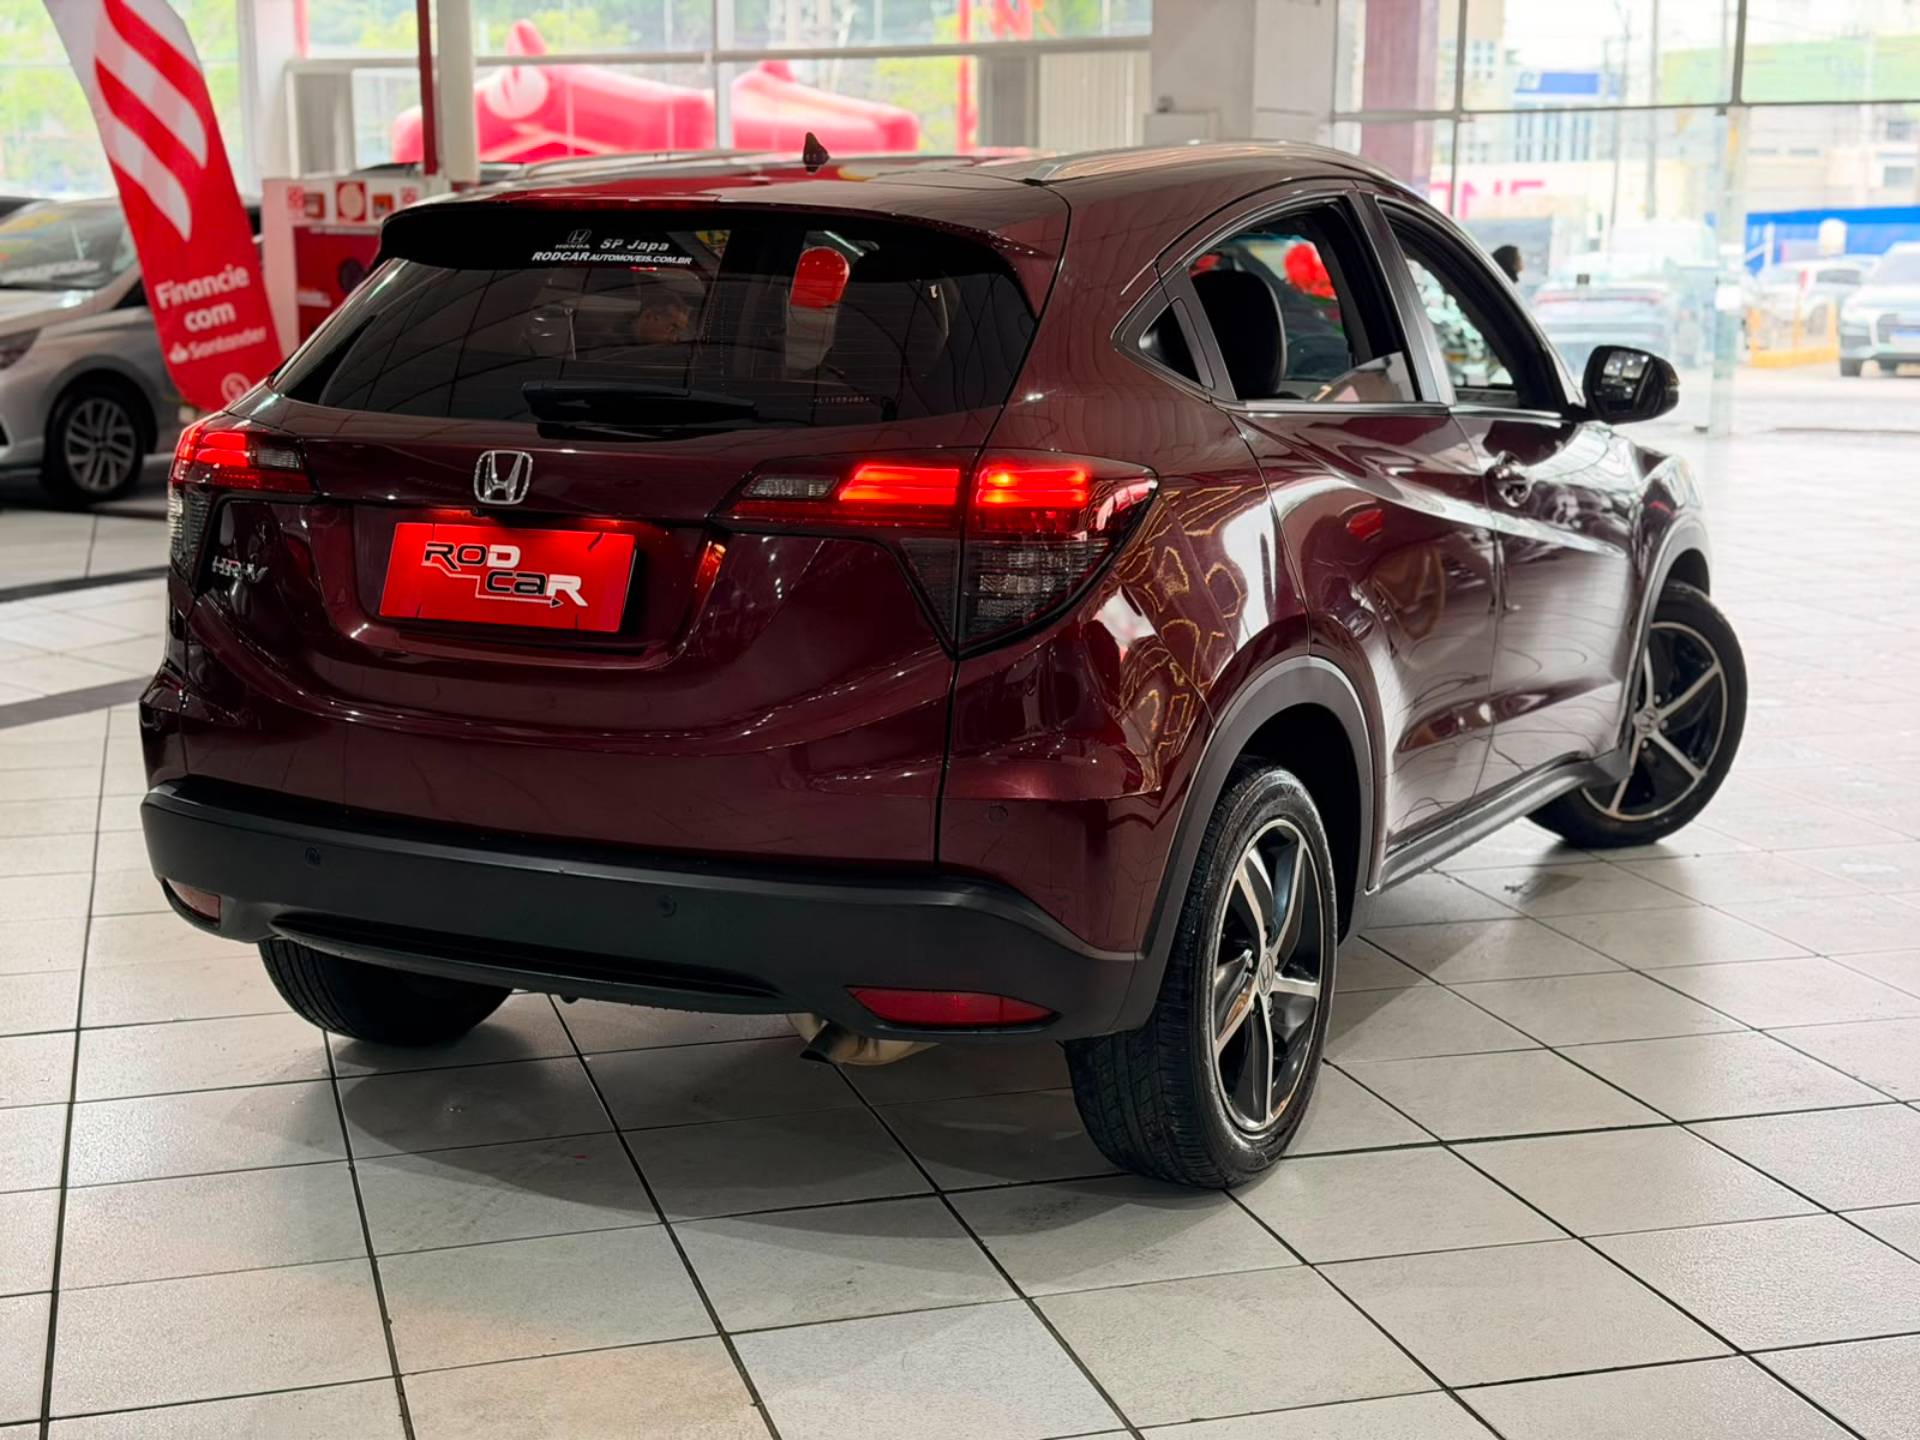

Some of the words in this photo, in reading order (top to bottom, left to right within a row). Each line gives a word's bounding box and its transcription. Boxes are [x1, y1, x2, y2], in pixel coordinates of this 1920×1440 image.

[600, 239, 624, 249] SP
[627, 240, 669, 252] Japa
[154, 264, 250, 309] Financie
[184, 302, 237, 333] com
[188, 327, 267, 361] Santander
